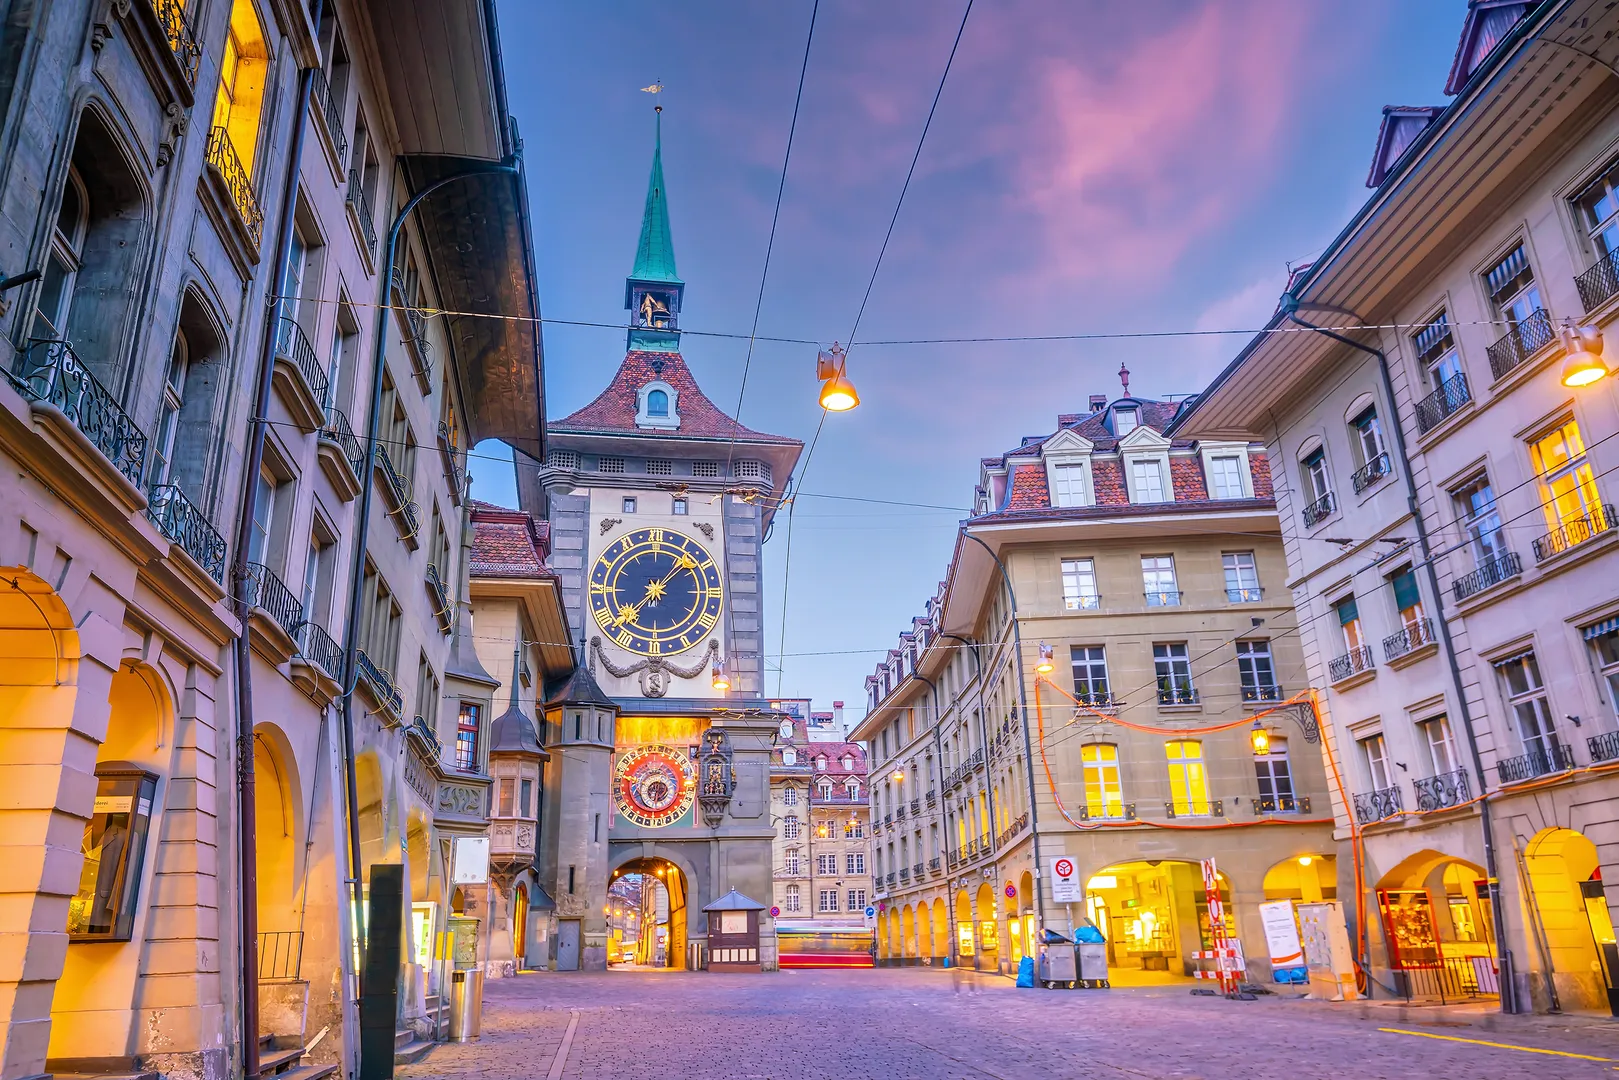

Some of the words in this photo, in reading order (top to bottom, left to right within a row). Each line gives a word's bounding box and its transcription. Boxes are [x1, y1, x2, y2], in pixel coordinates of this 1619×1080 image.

[648, 529, 663, 542] XII
[621, 537, 634, 550] XI
[682, 539, 690, 549] I
[601, 557, 612, 569] X
[701, 559, 712, 570] II
[591, 580, 604, 594] IX
[708, 587, 721, 598] III
[699, 613, 715, 629] IIII
